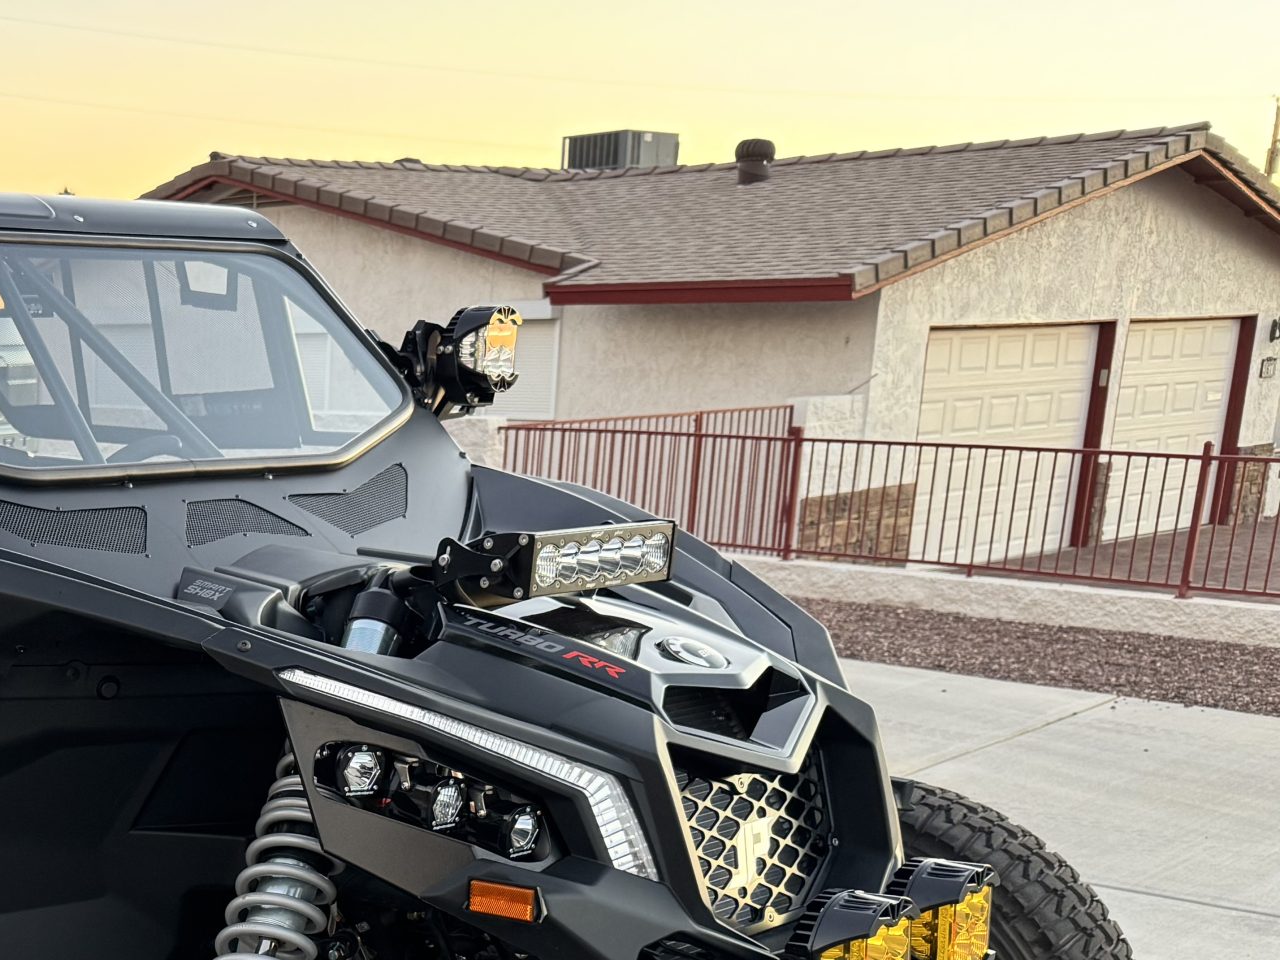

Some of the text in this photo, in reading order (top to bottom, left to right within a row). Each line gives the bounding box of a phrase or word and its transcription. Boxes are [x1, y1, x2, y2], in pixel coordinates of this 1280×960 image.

[183, 584, 225, 601] SHOX
[194, 579, 233, 594] SMART
[463, 616, 627, 680] TURBO RR
